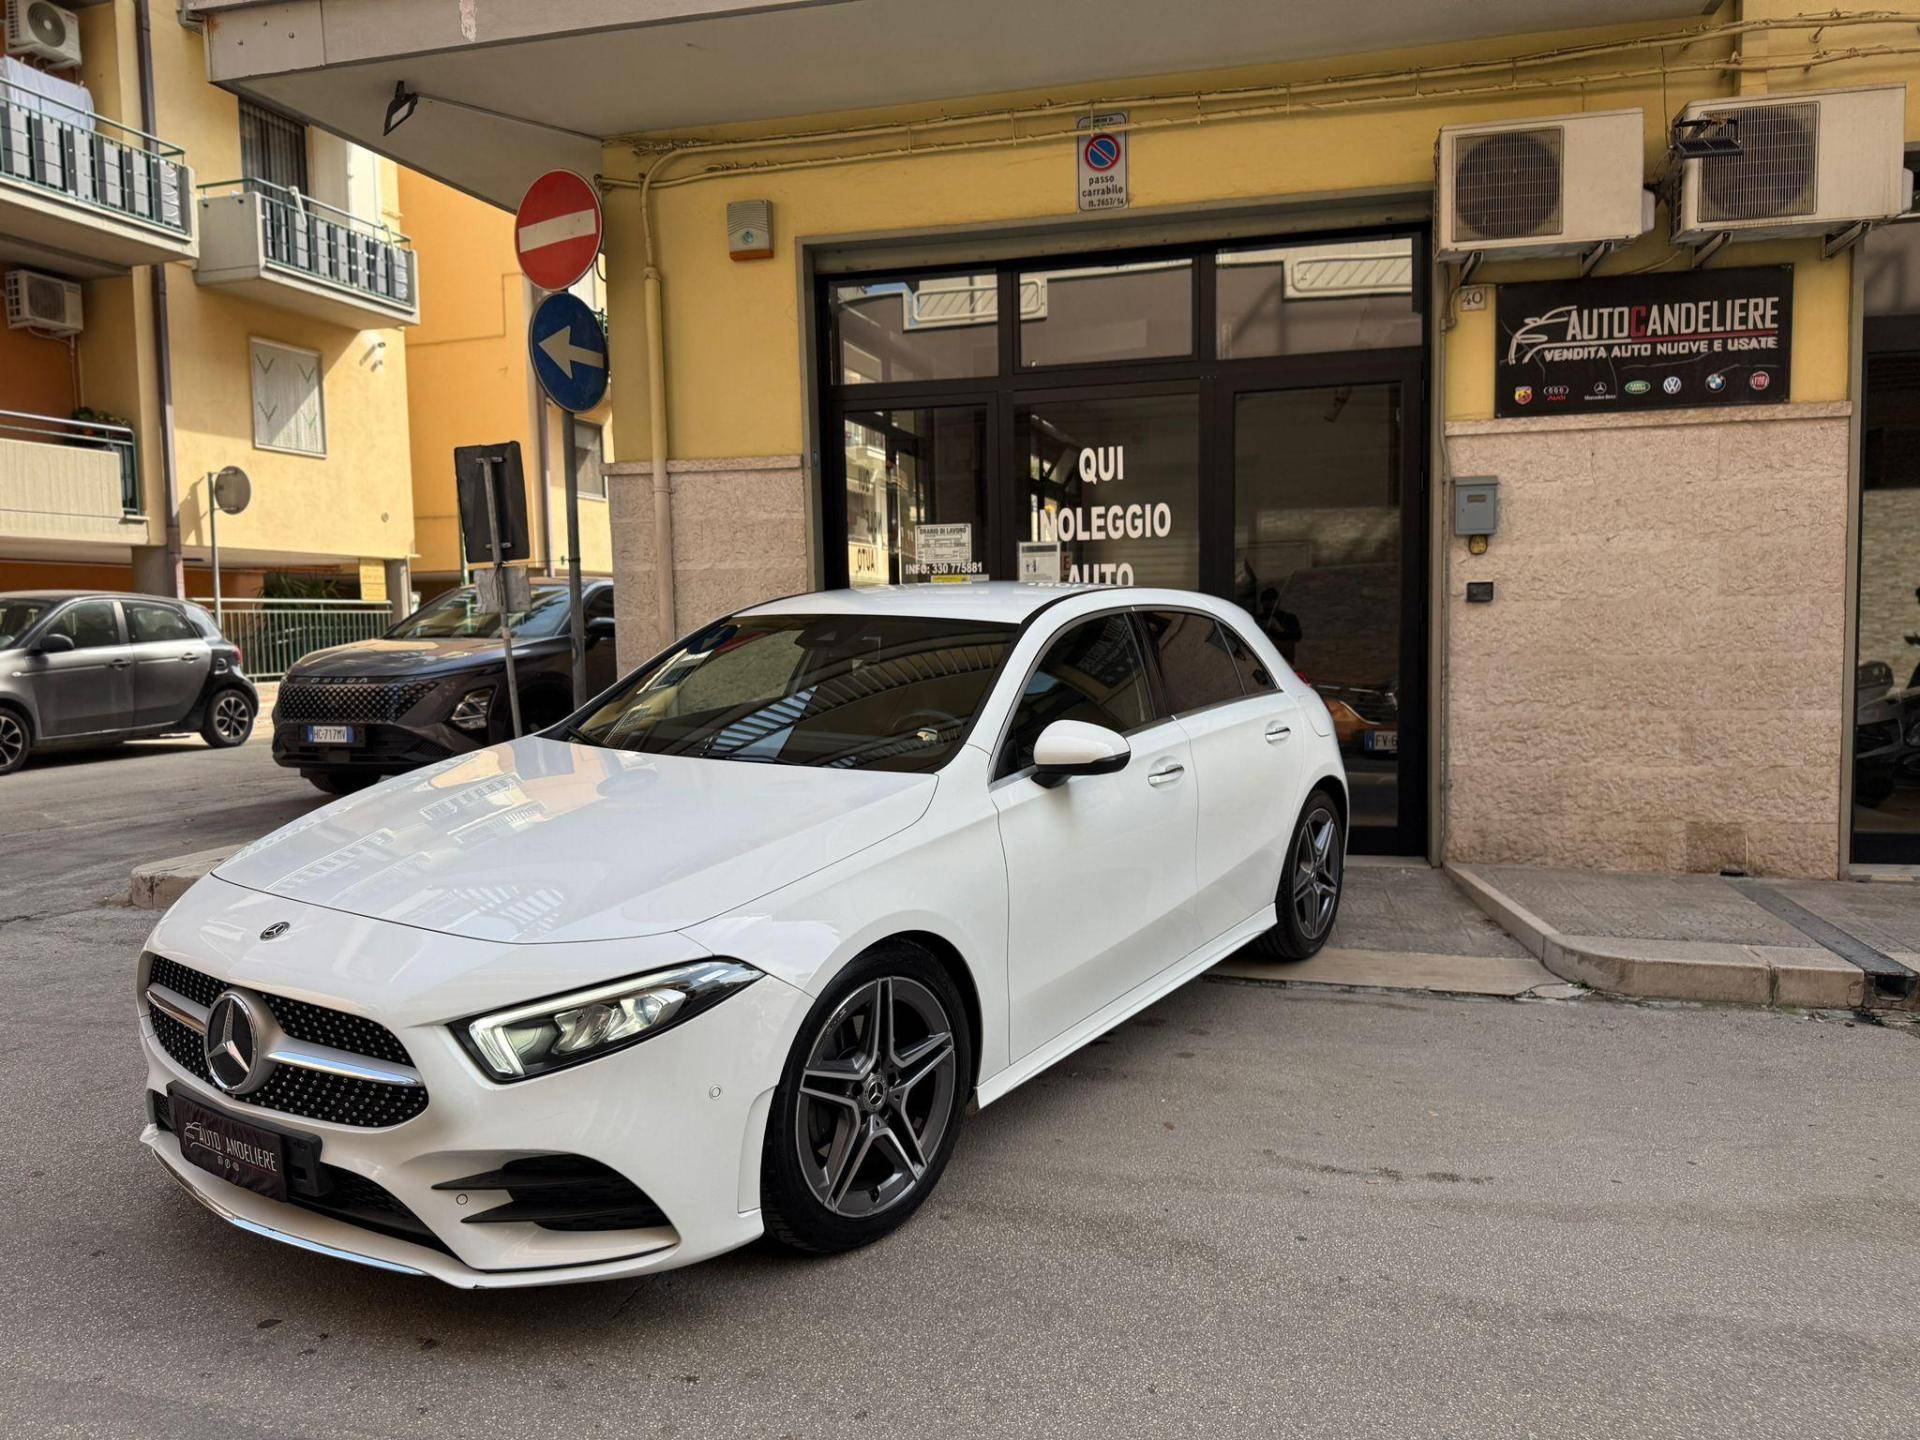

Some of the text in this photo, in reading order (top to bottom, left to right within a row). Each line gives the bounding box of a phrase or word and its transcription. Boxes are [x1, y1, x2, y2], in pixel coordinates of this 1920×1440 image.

[1089, 175, 1114, 186] passo
[1461, 291, 1483, 305] 40
[1566, 297, 1779, 341] AUTOCANDELIERE
[1543, 337, 1778, 362] VENDITA AUTO NUOVE E USATE
[1079, 446, 1124, 485] QUI
[1039, 503, 1171, 542] NOLEGGIO
[905, 562, 982, 575] INFO: 330 775881
[1068, 562, 1134, 587] AUTO
[199, 1126, 221, 1150] AUTO
